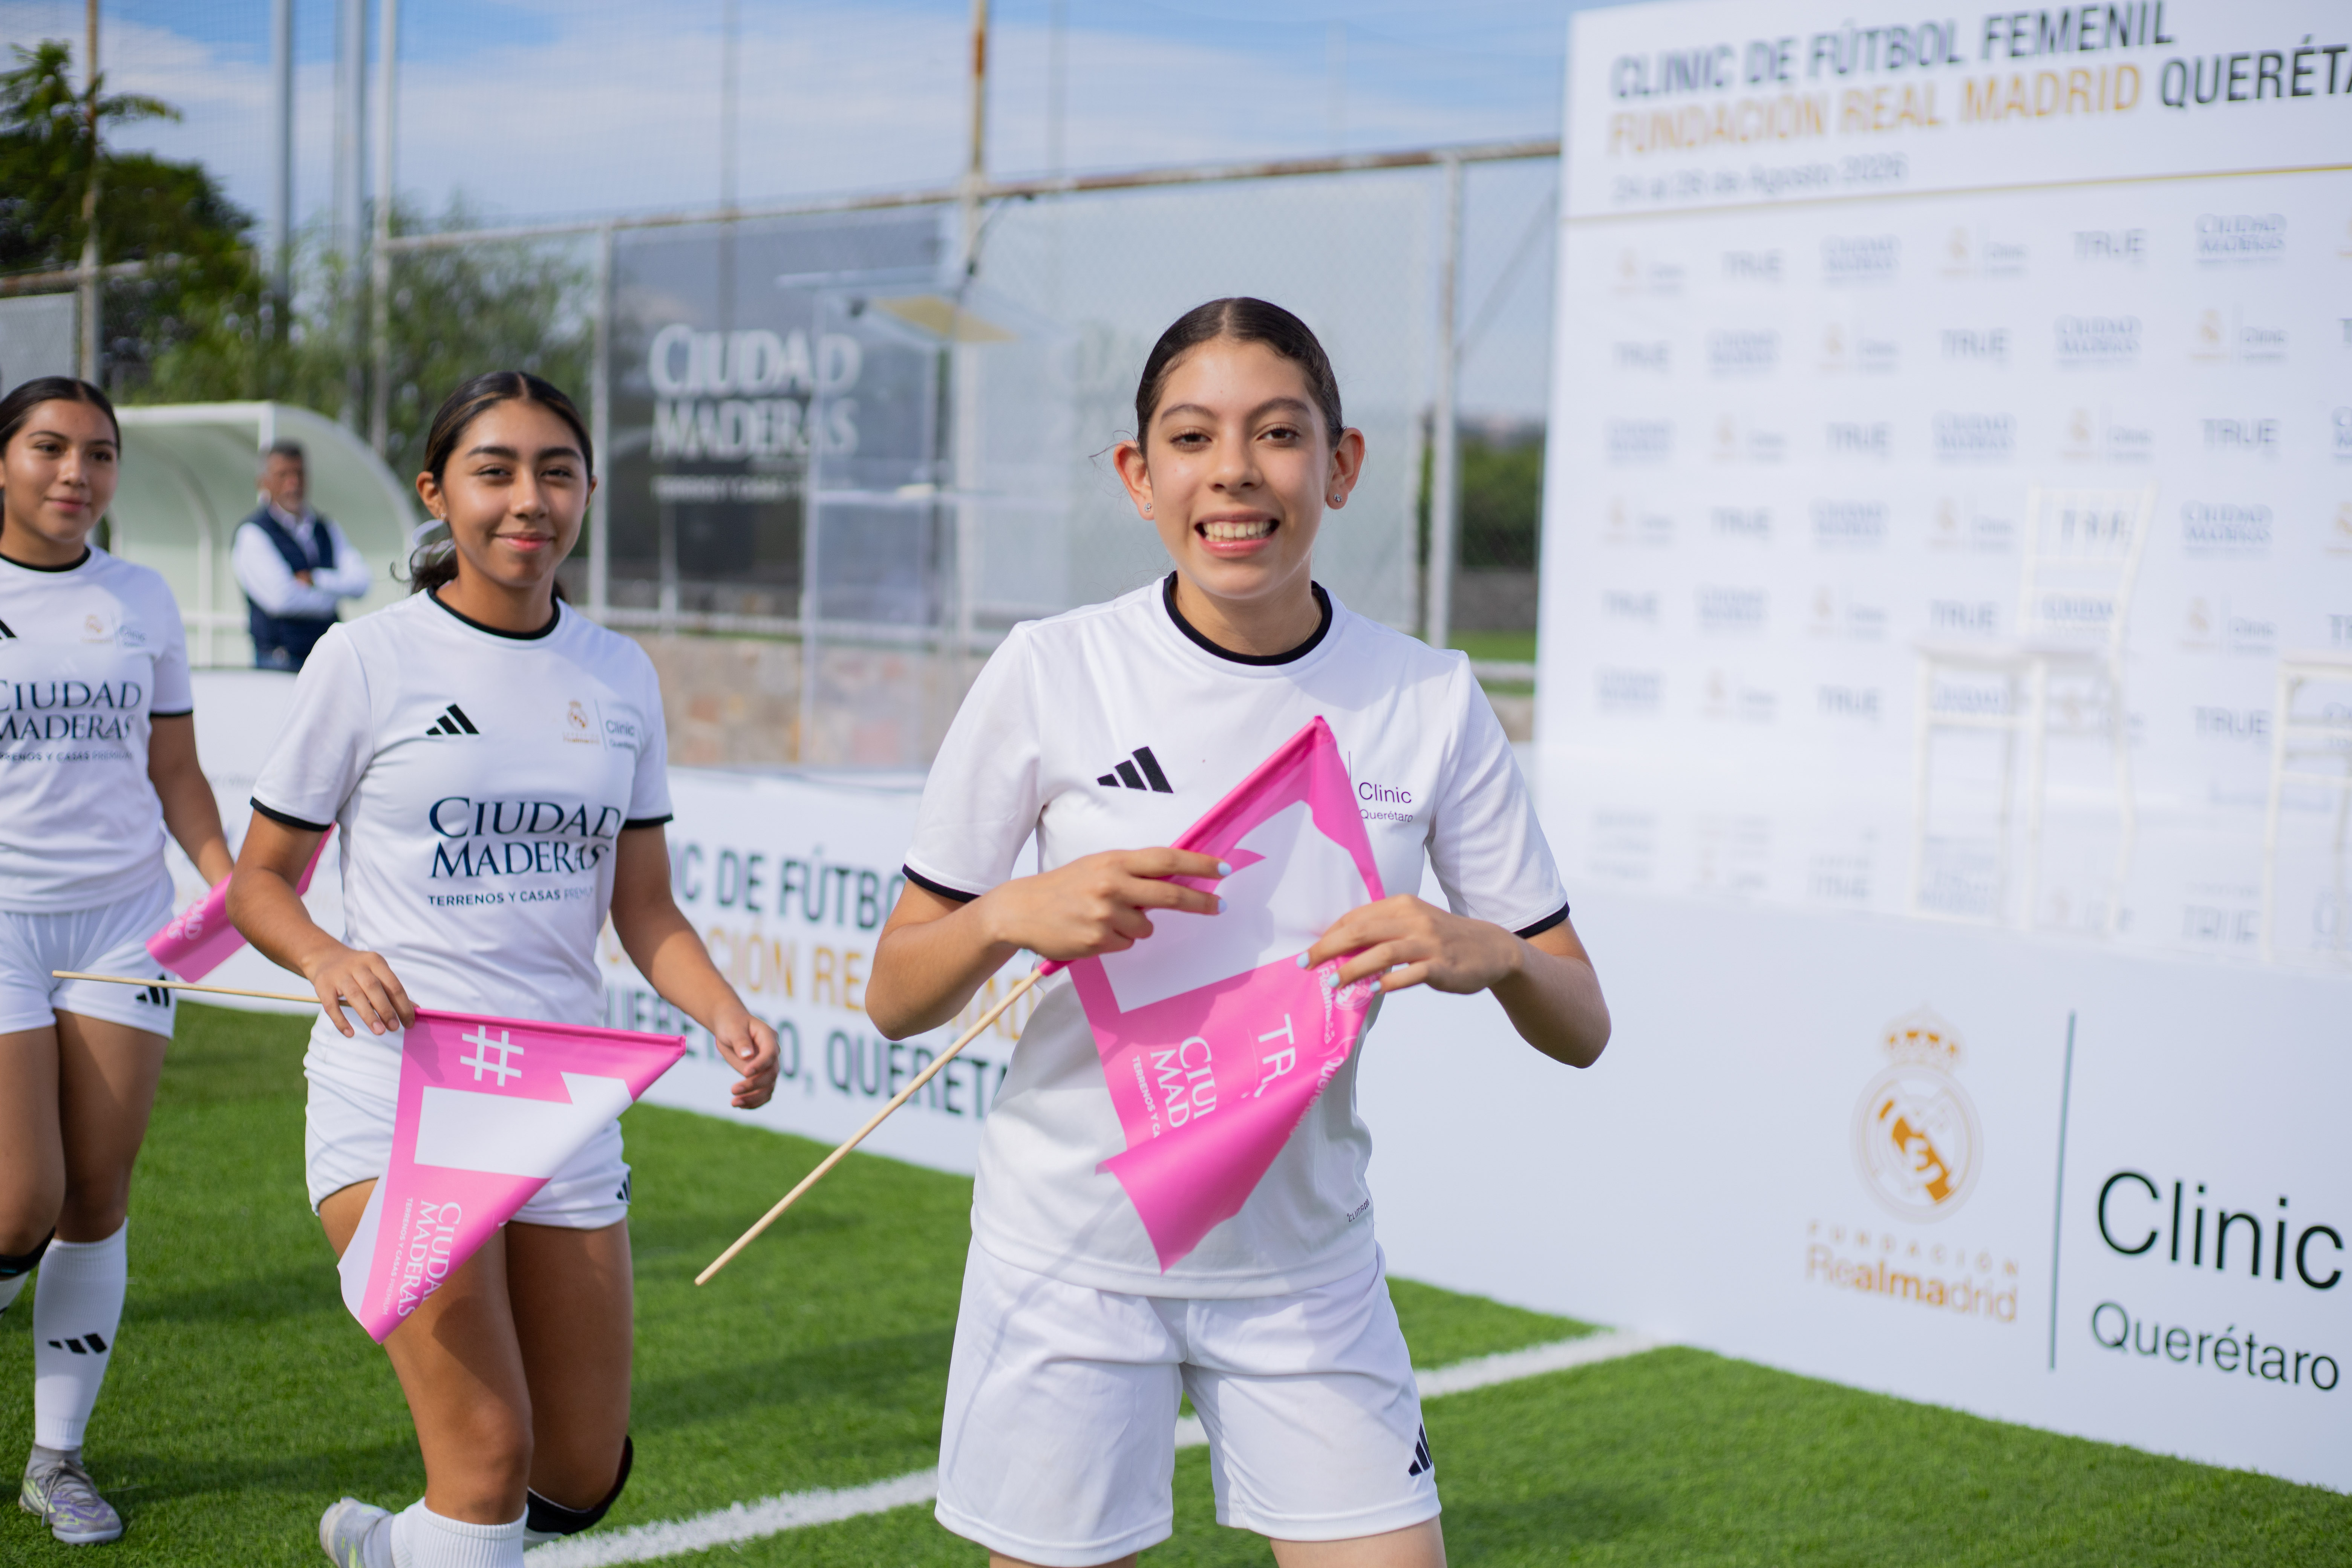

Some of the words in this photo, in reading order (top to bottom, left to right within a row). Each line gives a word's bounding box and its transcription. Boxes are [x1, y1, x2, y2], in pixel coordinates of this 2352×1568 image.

[1612, 43, 1735, 101] CLINIC
[1744, 38, 1799, 84] DE
[1808, 18, 1966, 74] FÚTBOL
[1981, 0, 2178, 60] FEMENIL
[1609, 89, 1828, 155] FUNDACIÓN
[1839, 81, 1943, 134] REAL
[1961, 63, 2142, 122] MADRID
[649, 323, 864, 398] CIUDAD
[651, 398, 859, 463] MADERAS
[2201, 417, 2280, 451] TRUE
[606, 720, 635, 737] Clinic
[429, 796, 622, 839] CIUDAD
[1359, 782, 1412, 803] Clinic
[1360, 809, 1413, 822] Querétaro
[428, 840, 609, 879] MADERAS
[717, 849, 765, 912] DE
[427, 891, 504, 906] TERRENOS
[508, 891, 516, 903] Y
[520, 889, 560, 902] CASAS
[1132, 1055, 1156, 1112] TERRENOS
[1150, 1112, 1159, 1121] Y
[399, 1197, 413, 1240] TERRENOS
[1807, 1218, 2019, 1278] FUNDACIÓN
[2097, 1170, 2344, 1291] Clinic
[391, 1250, 403, 1277] CASAS
[397, 1199, 441, 1317] MADERAS
[421, 1201, 462, 1304] CIUDA
[1805, 1242, 2018, 1324] Realmadrid
[382, 1278, 395, 1316] PREMIUM
[2091, 1300, 2340, 1391] Querétaro
